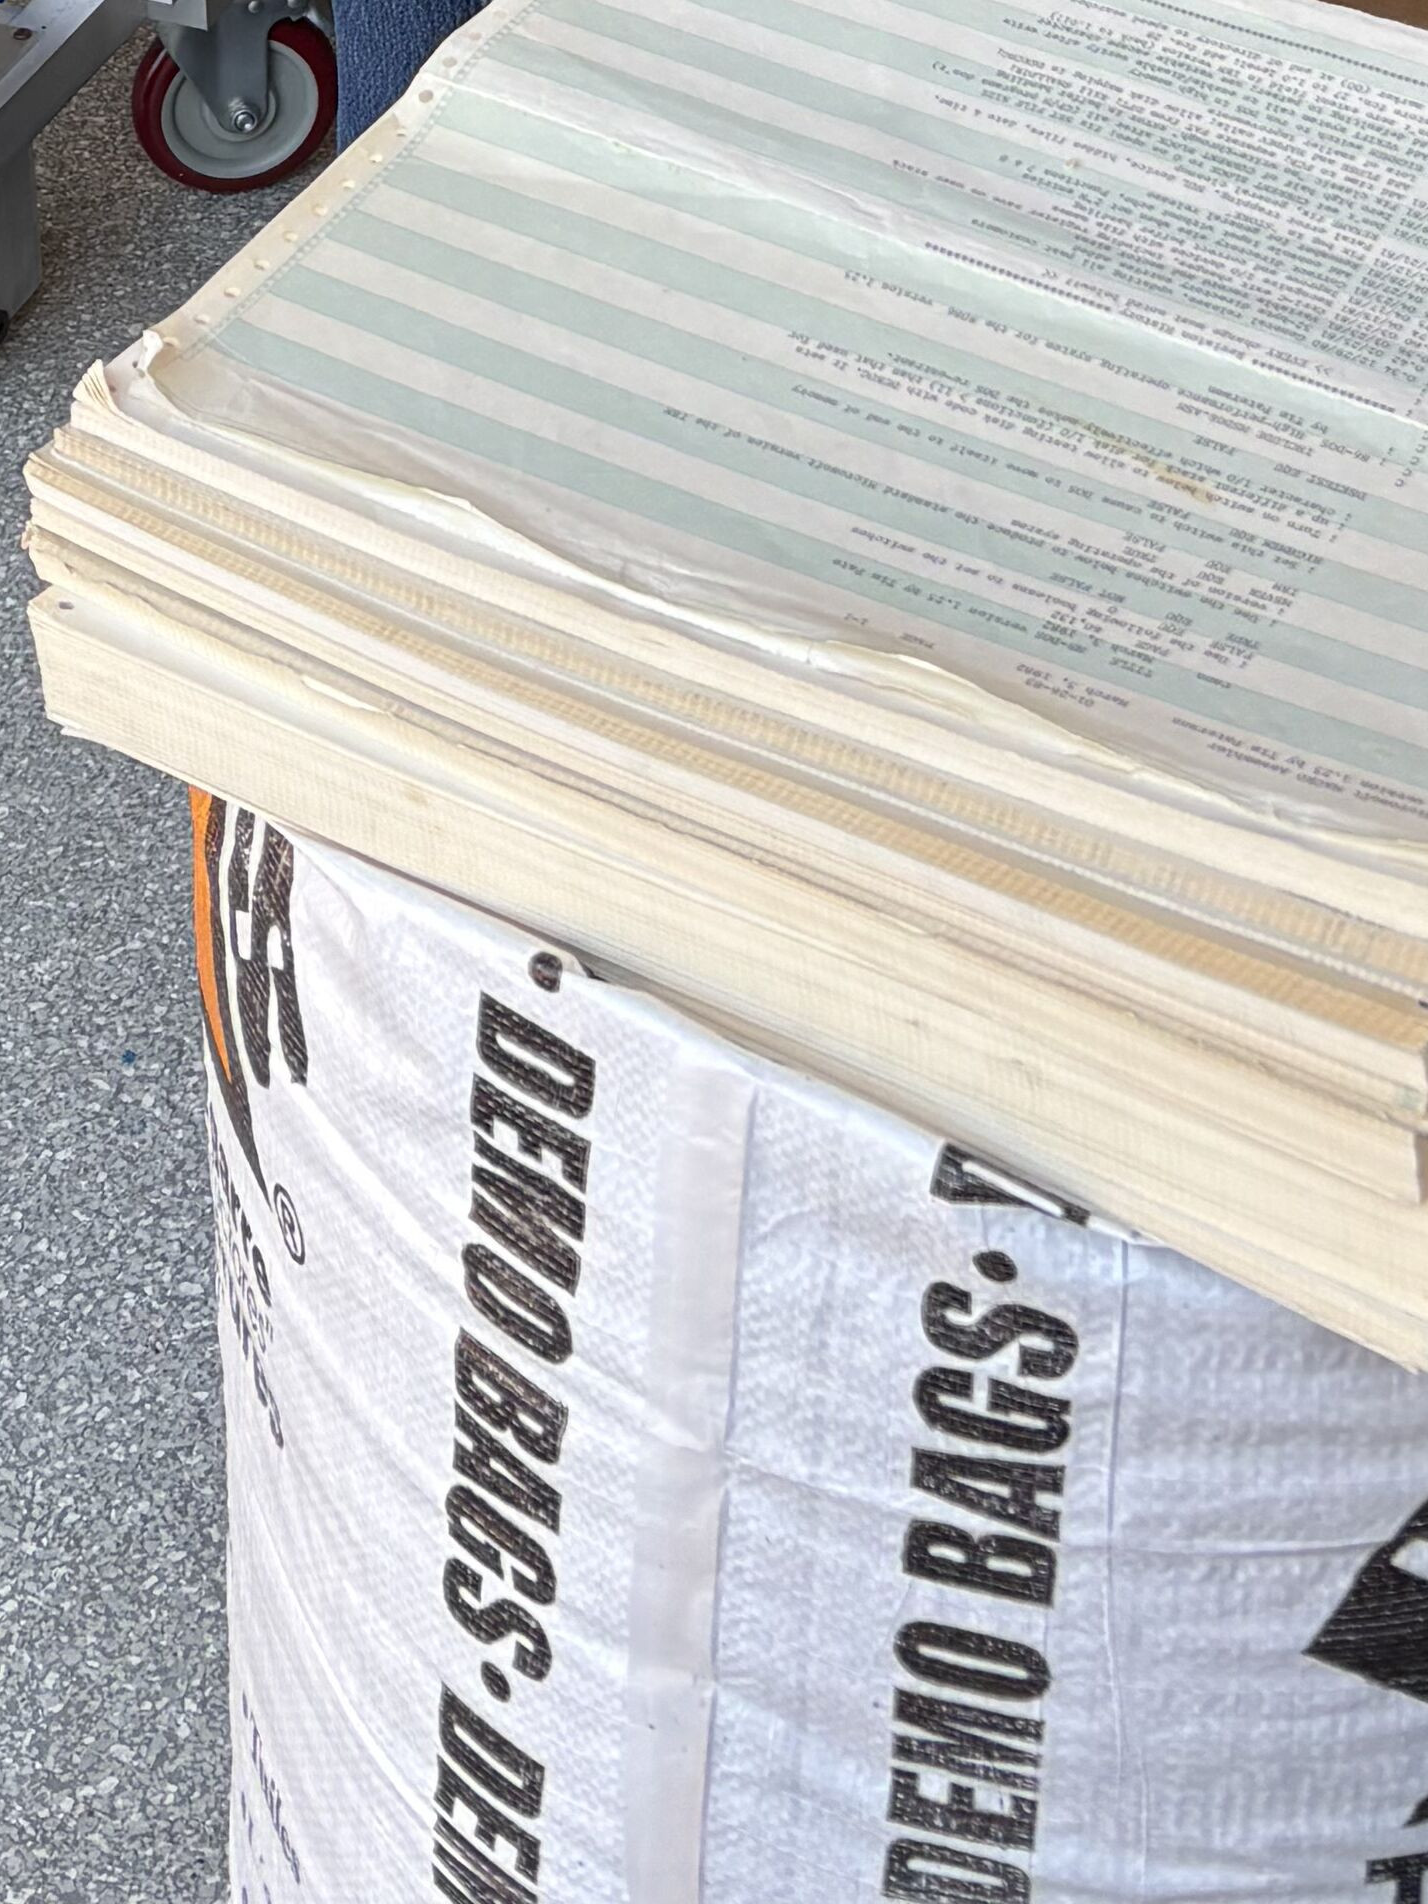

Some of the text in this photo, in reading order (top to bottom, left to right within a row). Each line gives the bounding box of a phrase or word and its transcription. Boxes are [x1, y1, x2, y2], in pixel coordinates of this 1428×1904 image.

[461, 990, 596, 1366] DEMO
[442, 1325, 569, 1684] BAGS
[901, 1280, 1079, 1608] BAGS
[883, 1620, 1053, 1904] DEMO
